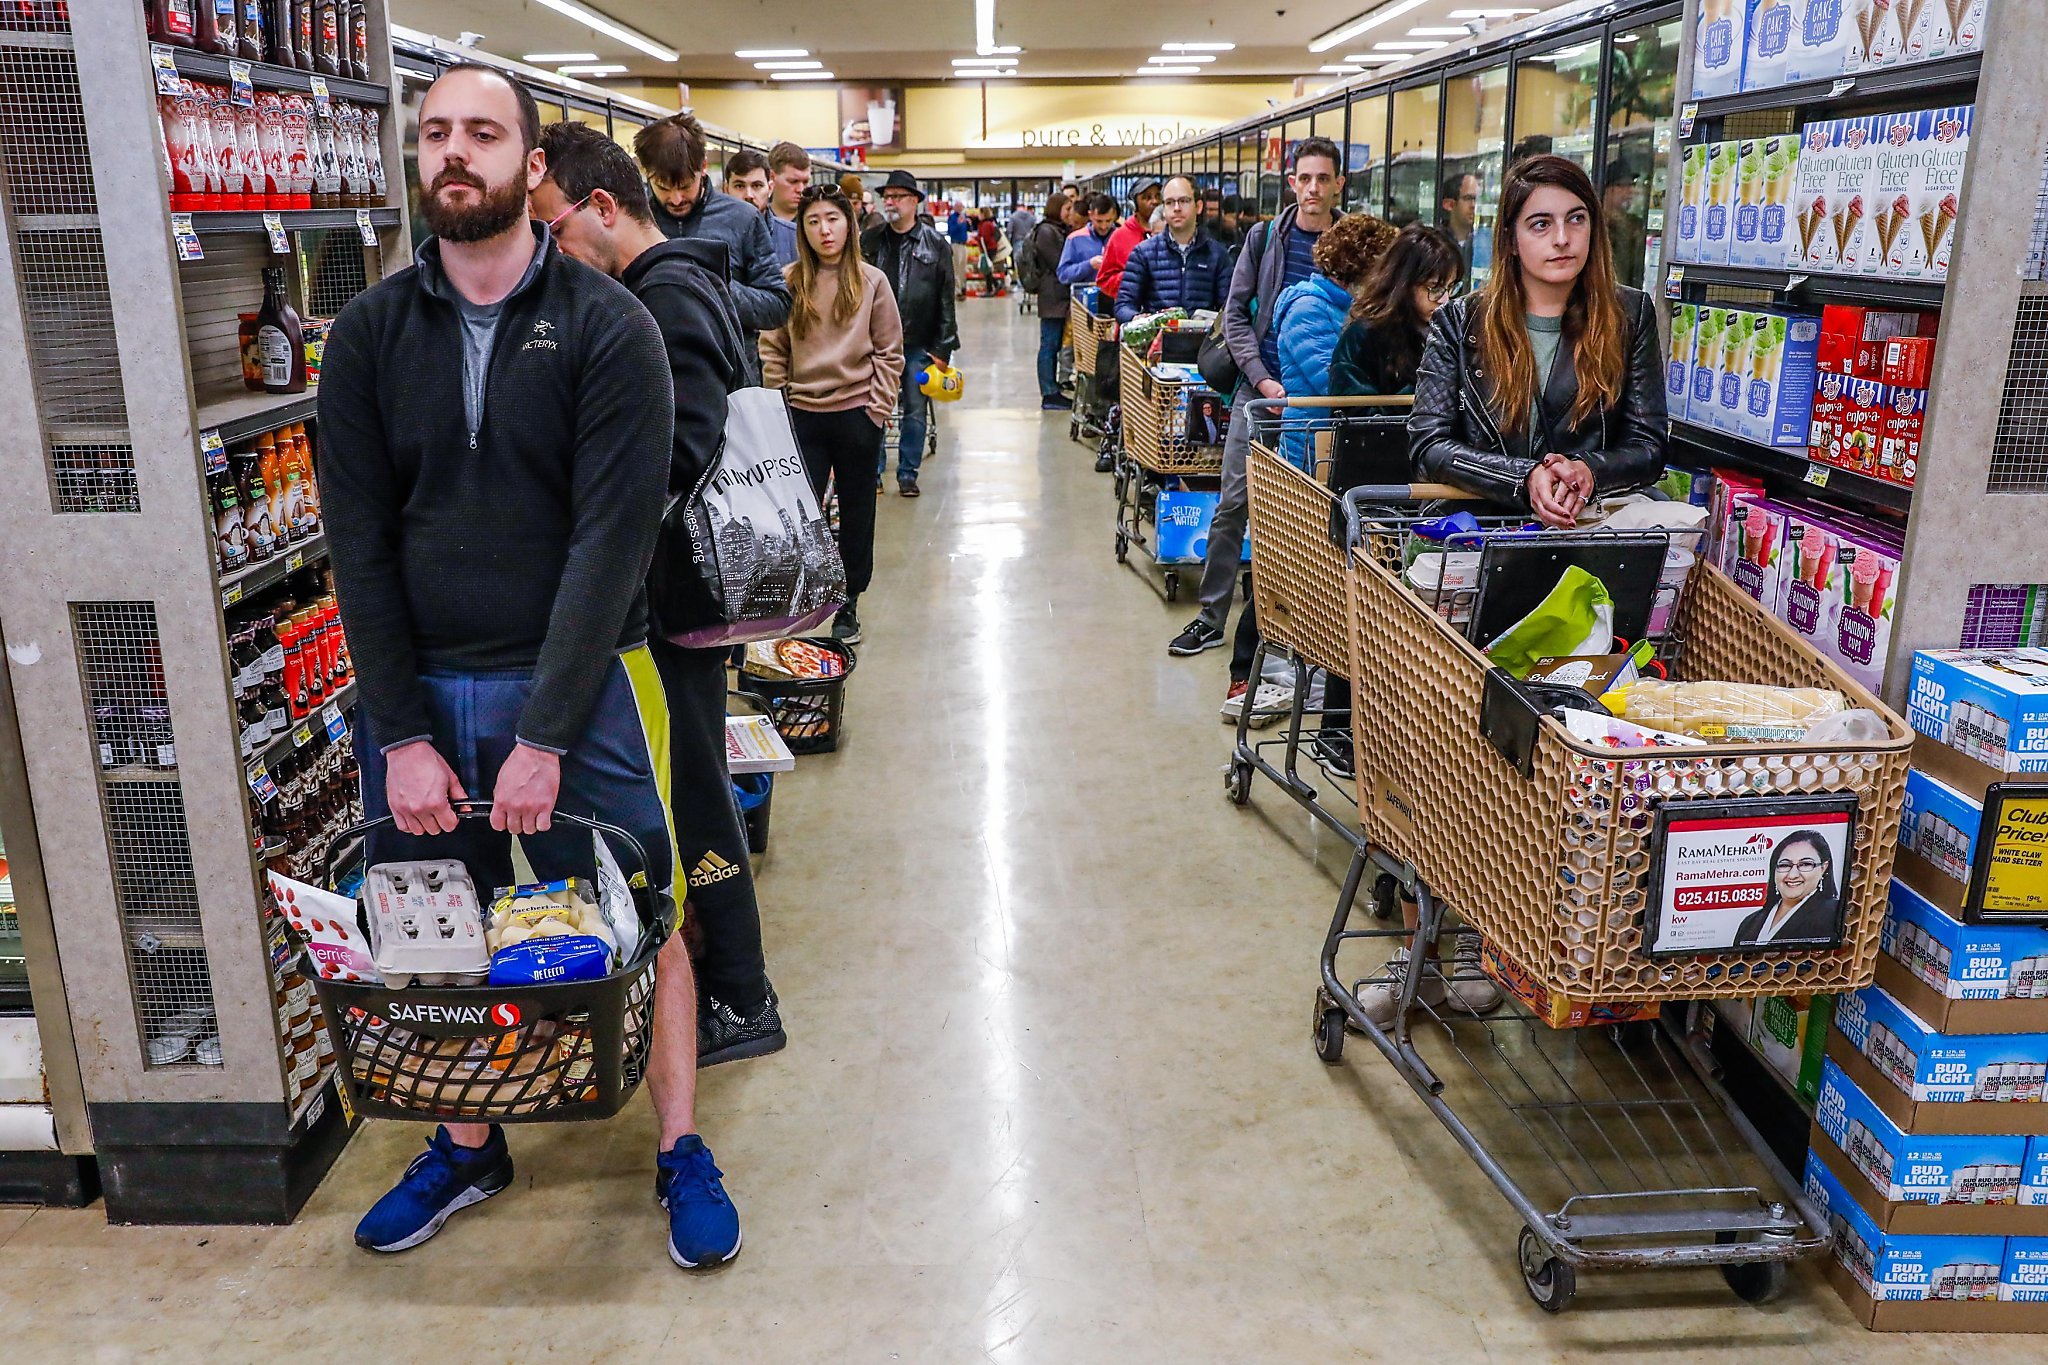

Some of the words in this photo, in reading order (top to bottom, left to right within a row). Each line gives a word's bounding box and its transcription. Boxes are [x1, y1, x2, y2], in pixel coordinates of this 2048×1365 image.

[1812, 0, 1833, 20] CAKE
[1766, 14, 1783, 35] CAKE
[1812, 20, 1828, 36] CUPS
[1710, 28, 1726, 47] CAKE
[1766, 34, 1780, 48] CUPS
[1710, 47, 1722, 60] CUPS
[1022, 129, 1080, 148] pure
[1090, 124, 1106, 146] &
[1800, 156, 1834, 172] Gluten
[1835, 154, 1872, 172] Gluten
[1877, 152, 1919, 170] Gluten
[1802, 172, 1826, 188] Free
[1838, 171, 1864, 186] Free
[1880, 169, 1910, 186] Free
[1926, 168, 1958, 184] Free
[1742, 211, 1754, 226] CAKE
[1767, 212, 1780, 226] CAKE
[1752, 385, 1767, 401] CAKE
[1172, 506, 1201, 517] SELTZER
[1174, 516, 1200, 527] WATER
[1738, 567, 1760, 588] RAINBOW
[1792, 590, 1816, 612] RAINBOW
[1796, 608, 1807, 623] CUPS
[1843, 618, 1870, 642] RAINBOW
[1848, 636, 1862, 653] CUPS
[1915, 656, 1922, 664] 12
[1528, 672, 1609, 682] Enlightened
[1917, 676, 1946, 701] BUD
[1911, 690, 1949, 720] LIGHT
[1958, 718, 1968, 728] BUD
[2022, 712, 2035, 720] 12
[1911, 708, 1943, 741] SELTZER
[1970, 723, 1980, 733] BUD
[1748, 728, 1785, 738] SOURDOUGH
[1982, 728, 1994, 740] BUD
[1994, 734, 2006, 744] BUD
[1386, 790, 1410, 818] SAFEWAY
[2008, 808, 2048, 825] Club
[1992, 856, 2011, 864] HARD
[2011, 857, 2043, 867] SELTZER
[1999, 848, 2020, 857] WHITE
[2021, 850, 2042, 860] CLAW
[689, 864, 740, 888] adidas
[1676, 868, 1765, 882] RamaMehra.com
[1678, 888, 1764, 906] 925.415.0835
[512, 904, 549, 914] Paccheri
[1672, 914, 1688, 924] kw
[1969, 958, 2002, 968] BUD
[534, 970, 543, 980] DE
[544, 966, 565, 979] CECCO
[1962, 968, 2007, 979] LIGHT
[1961, 988, 1999, 999] SELTZER
[388, 1002, 488, 1024] SAFEWAY
[1571, 1011, 1582, 1020] 12
[1770, 998, 1794, 1031] WAFFLE
[1839, 996, 1870, 1035] LIGHT
[1770, 1015, 1788, 1039] CONES
[1840, 1013, 1864, 1052] SELTZER
[1935, 1064, 1967, 1073] BUD
[1927, 1074, 1972, 1083] LIGHT
[1824, 1080, 1846, 1112] BUD
[1926, 1091, 1964, 1102] SELTZER
[1820, 1090, 1848, 1133] LIGHT
[1819, 1106, 1843, 1148] SELTZER
[1911, 1166, 1944, 1175] BUD
[1904, 1176, 1948, 1185] LIGHT
[1810, 1173, 1830, 1206] BUD
[1903, 1193, 1940, 1204] SELTZER
[1892, 1264, 1924, 1273] BUD
[2018, 1264, 2048, 1273] BUD
[1885, 1273, 1928, 1283] LIGHT
[1885, 1289, 1922, 1300] SELTZER
